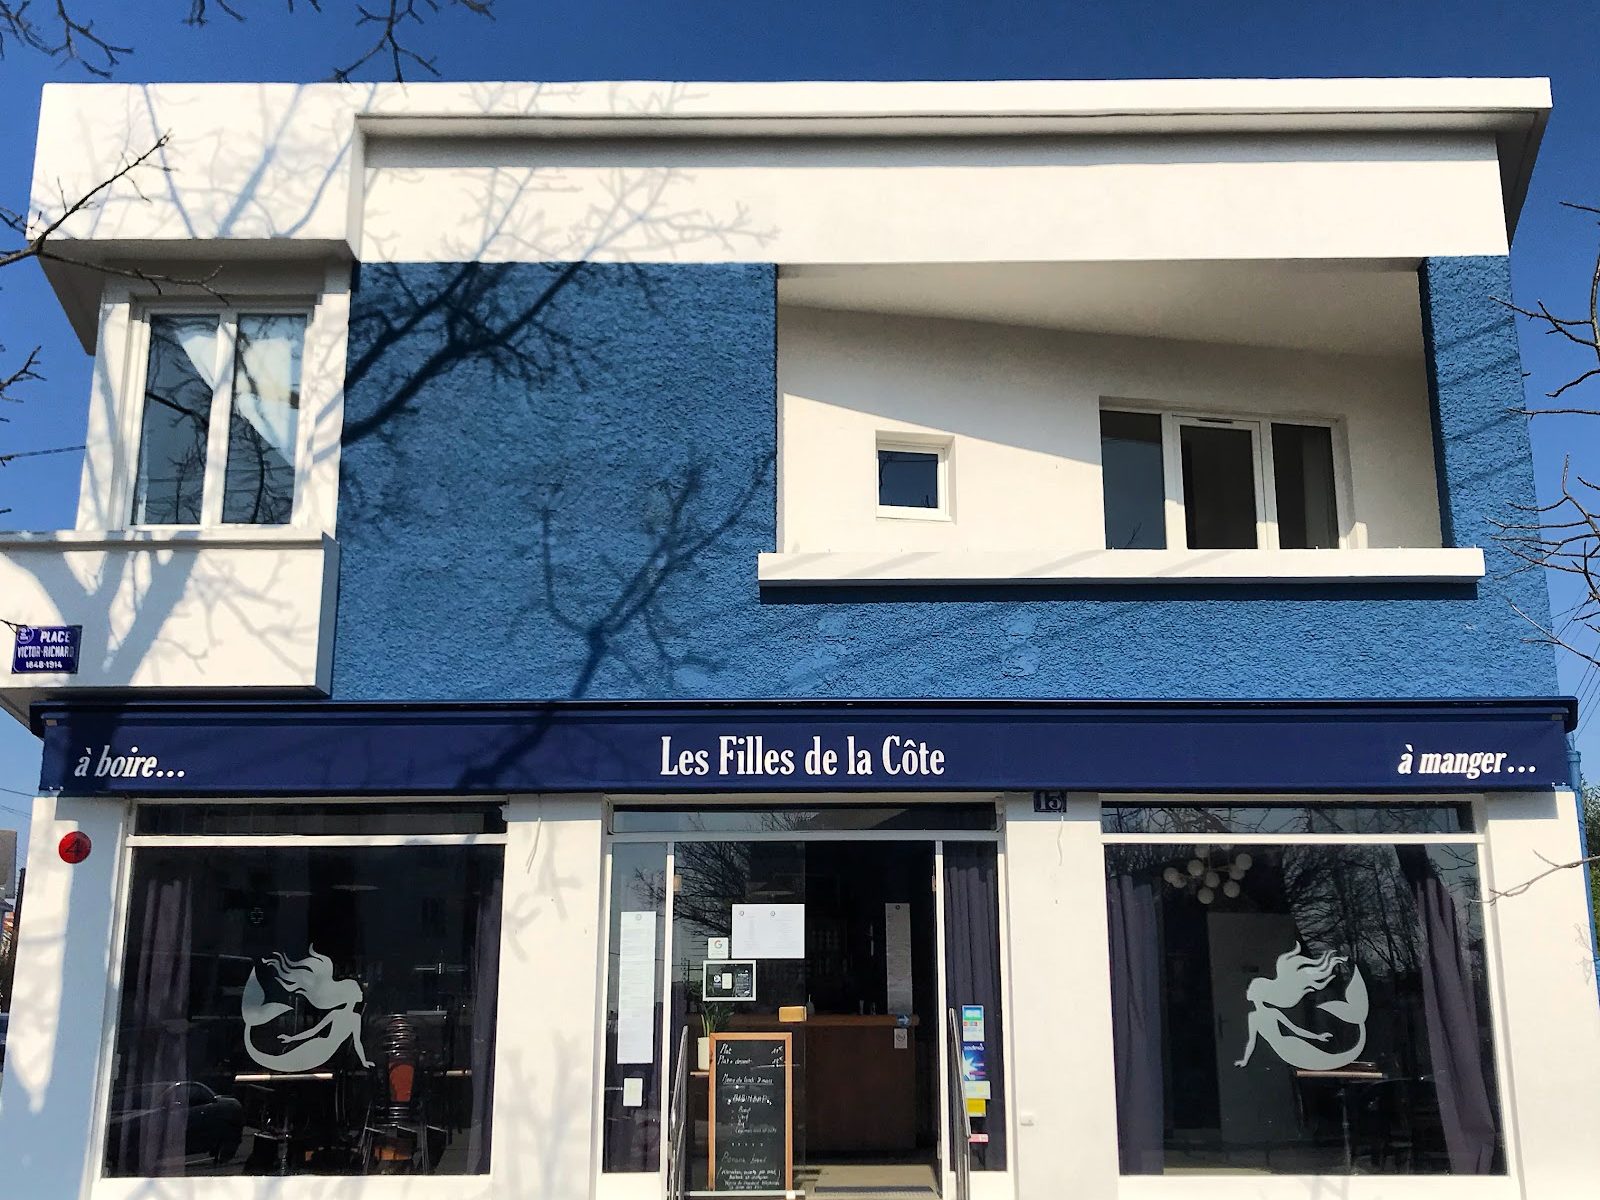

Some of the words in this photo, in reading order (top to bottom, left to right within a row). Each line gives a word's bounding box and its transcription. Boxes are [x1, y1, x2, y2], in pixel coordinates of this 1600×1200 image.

[17, 645, 75, 658] VICTOR-RICHARD
[40, 630, 71, 643] PLACE
[74, 747, 92, 777] à
[660, 735, 710, 775] Les
[718, 735, 795, 775] Filles
[804, 735, 838, 775] de
[846, 735, 873, 775] la
[882, 735, 945, 775] Côte
[1397, 744, 1413, 774] à
